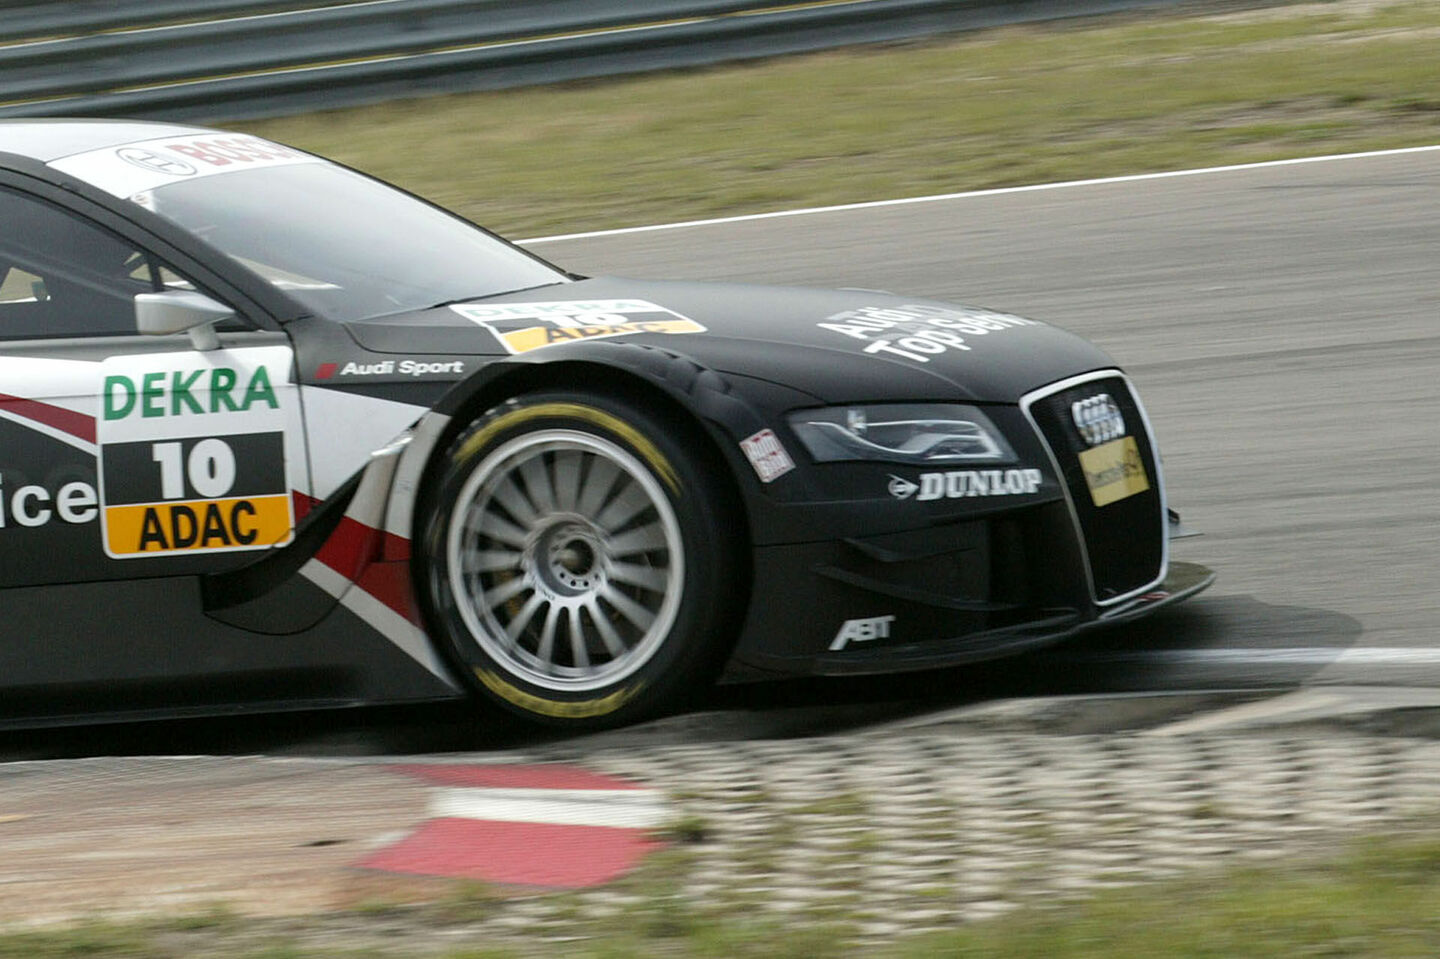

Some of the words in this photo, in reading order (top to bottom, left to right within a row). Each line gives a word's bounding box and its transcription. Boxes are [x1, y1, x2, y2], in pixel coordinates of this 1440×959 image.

[863, 329, 971, 363] Top
[340, 360, 395, 376] Audi
[398, 359, 464, 377] Sport
[103, 365, 280, 421] DEKRA
[152, 438, 237, 499] 10
[916, 468, 1043, 501] DUNLOP
[138, 500, 259, 552] ADAC
[828, 615, 896, 651] ABT
